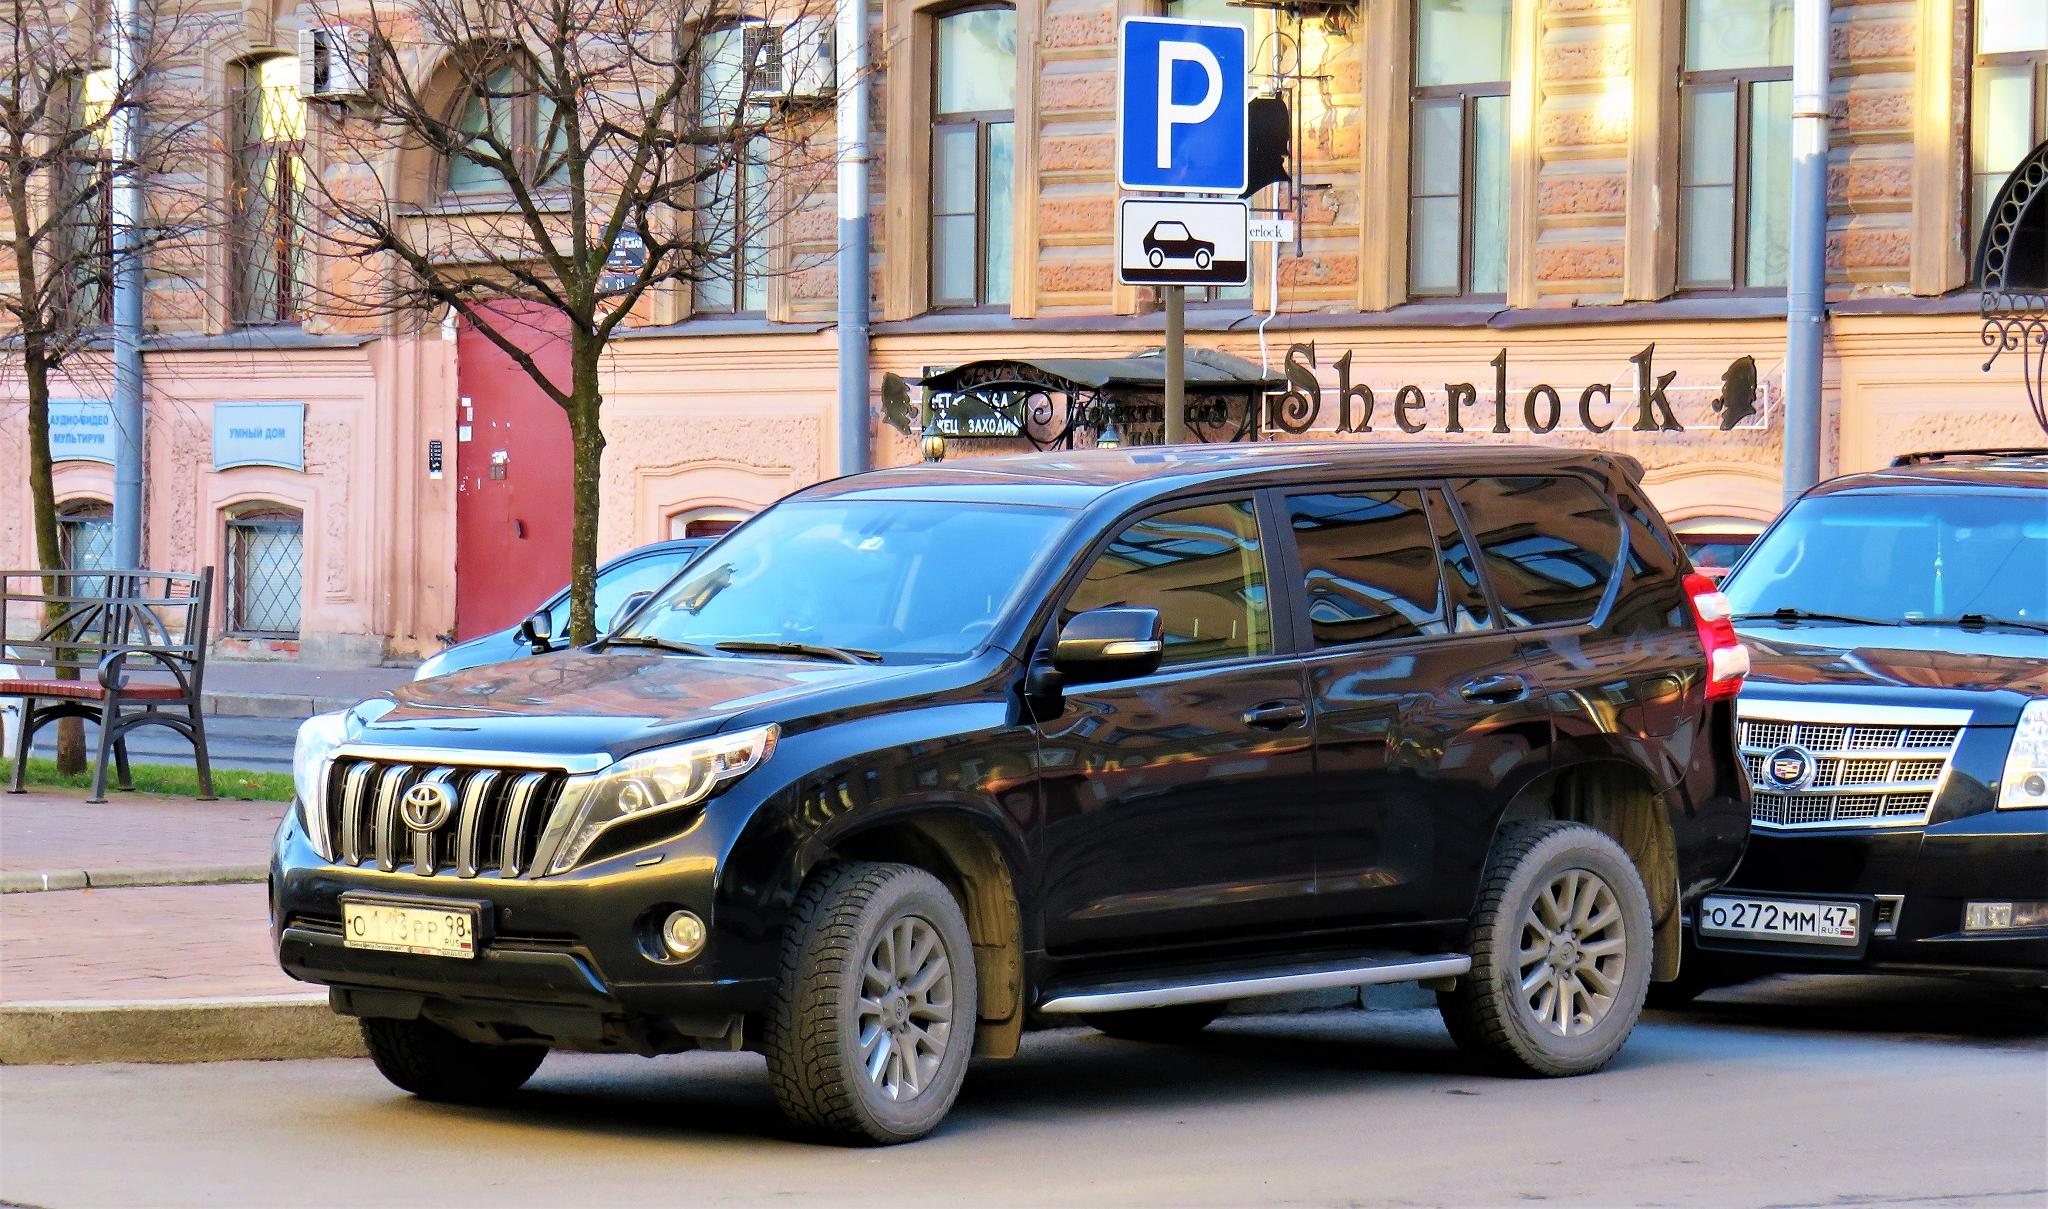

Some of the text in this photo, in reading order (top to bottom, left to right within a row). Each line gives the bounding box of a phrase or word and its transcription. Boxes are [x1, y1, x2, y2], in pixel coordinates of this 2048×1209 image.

[1157, 40, 1224, 169] P
[1274, 339, 1685, 435] Sherlock
[53, 433, 105, 444] МУЛЬТИРУМ
[265, 427, 286, 440] ДОМ
[1822, 907, 1848, 928] 47
[445, 915, 466, 938] 98
[1821, 926, 1840, 935] RUS
[444, 938, 460, 947] RUS
